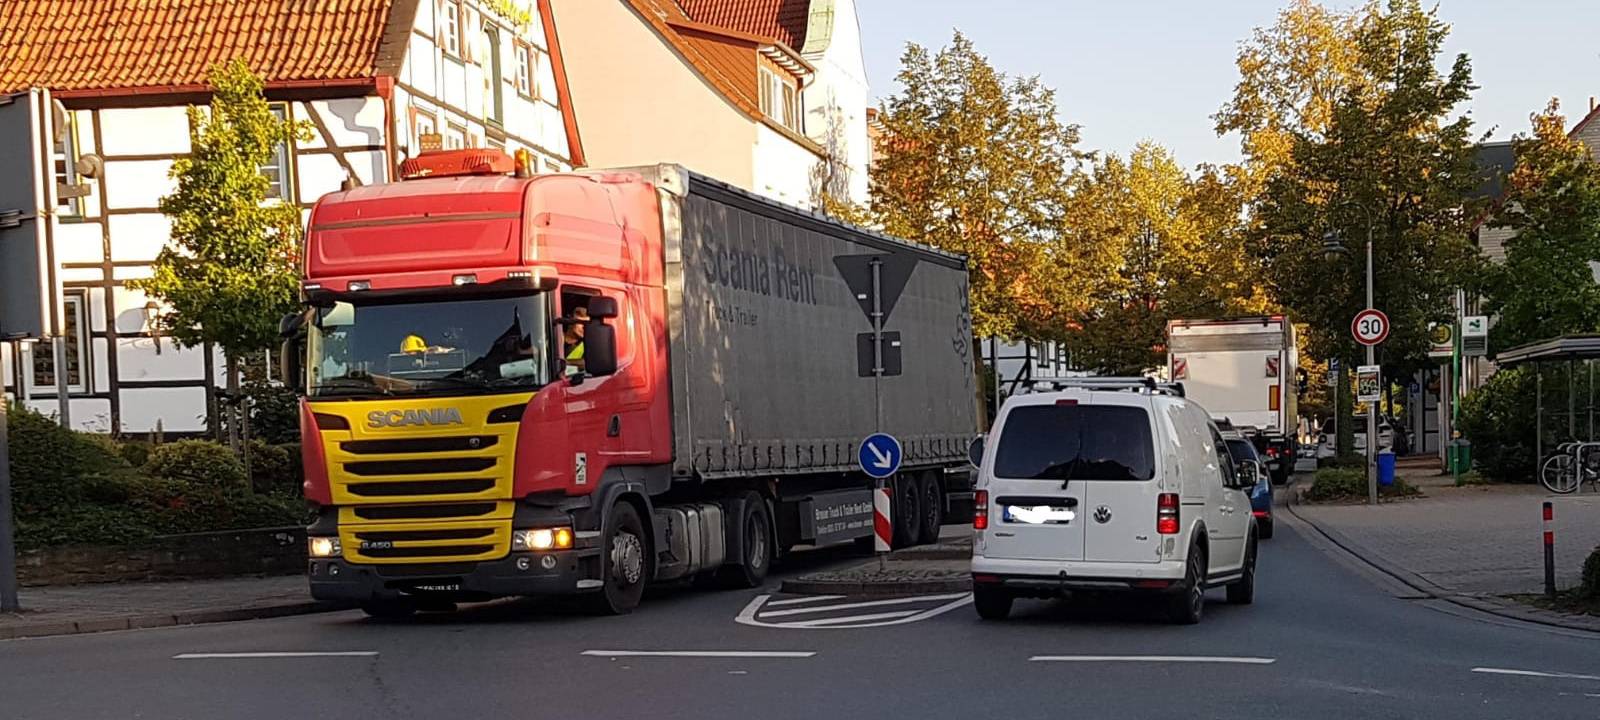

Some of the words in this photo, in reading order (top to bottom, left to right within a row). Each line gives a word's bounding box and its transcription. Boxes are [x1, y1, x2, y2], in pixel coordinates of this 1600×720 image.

[702, 229, 771, 296] Scania
[775, 246, 817, 306] Rent
[705, 300, 728, 321] Tck
[1360, 319, 1381, 335] 30
[367, 407, 464, 428] SCANIA
